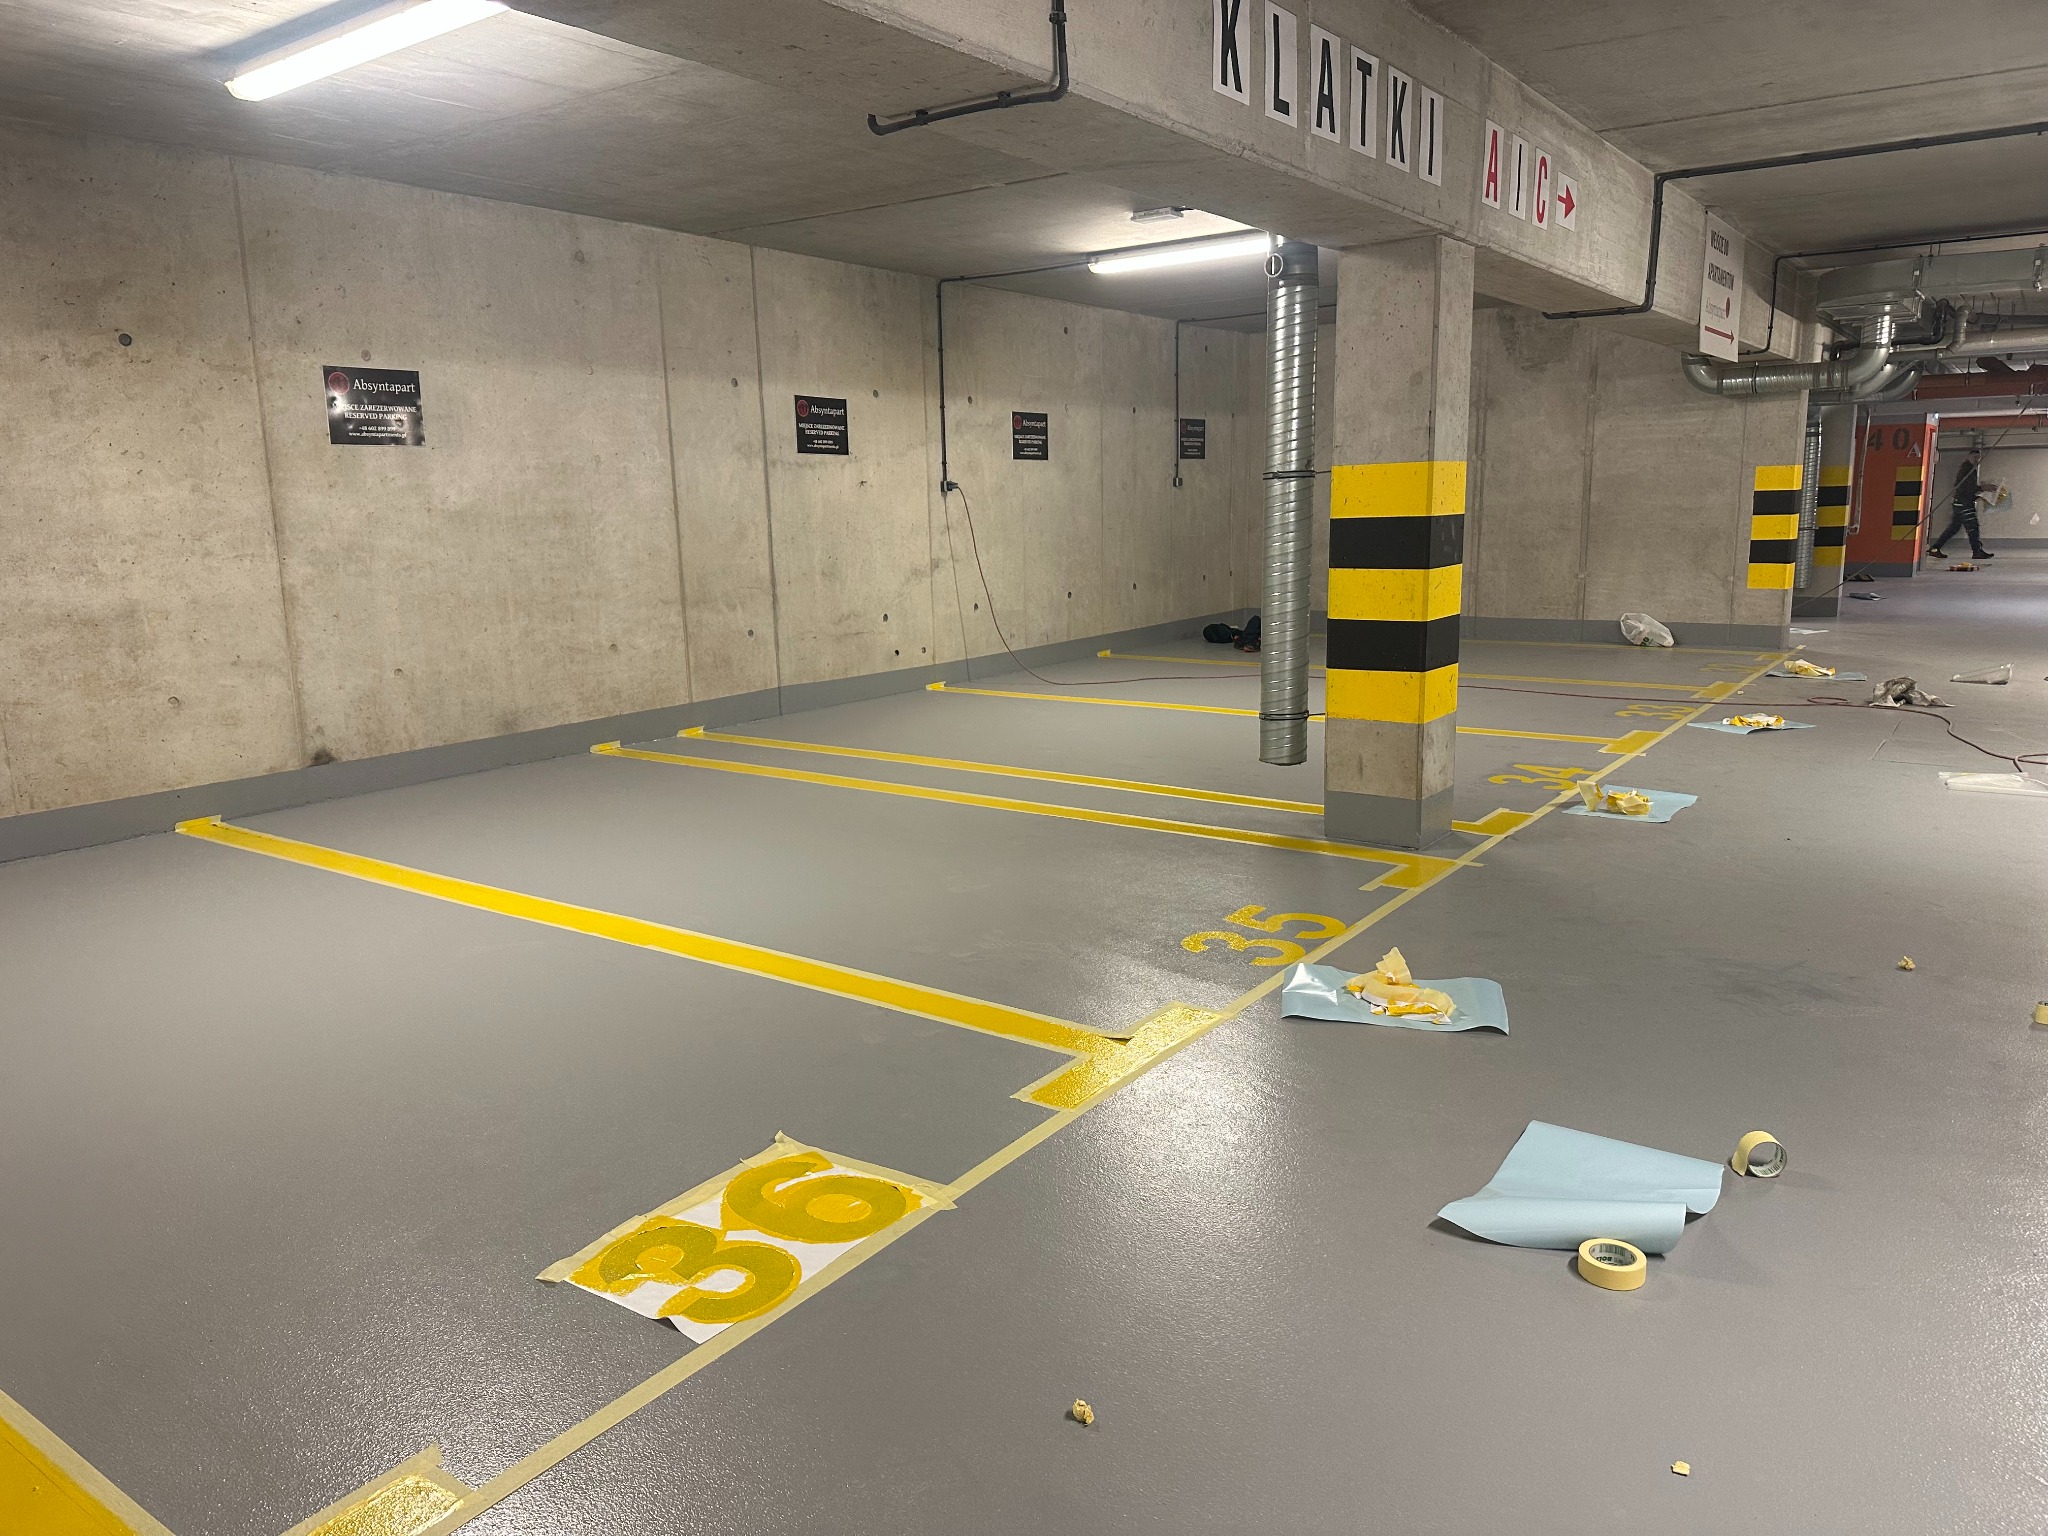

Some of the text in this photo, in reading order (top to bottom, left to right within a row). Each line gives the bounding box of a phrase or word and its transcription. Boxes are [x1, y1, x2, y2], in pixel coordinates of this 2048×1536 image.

[1220, 0, 1435, 176] KLATKI
[353, 379, 416, 394] Absyntapart
[344, 412, 408, 421] RESERVED PARKING
[360, 404, 417, 413] ZAREZERWOWANE
[811, 405, 844, 417] Absyntapart
[1614, 703, 1697, 721] 33
[1488, 763, 1601, 790] 34
[1180, 904, 1347, 967] 35
[578, 1153, 914, 1323] 36
